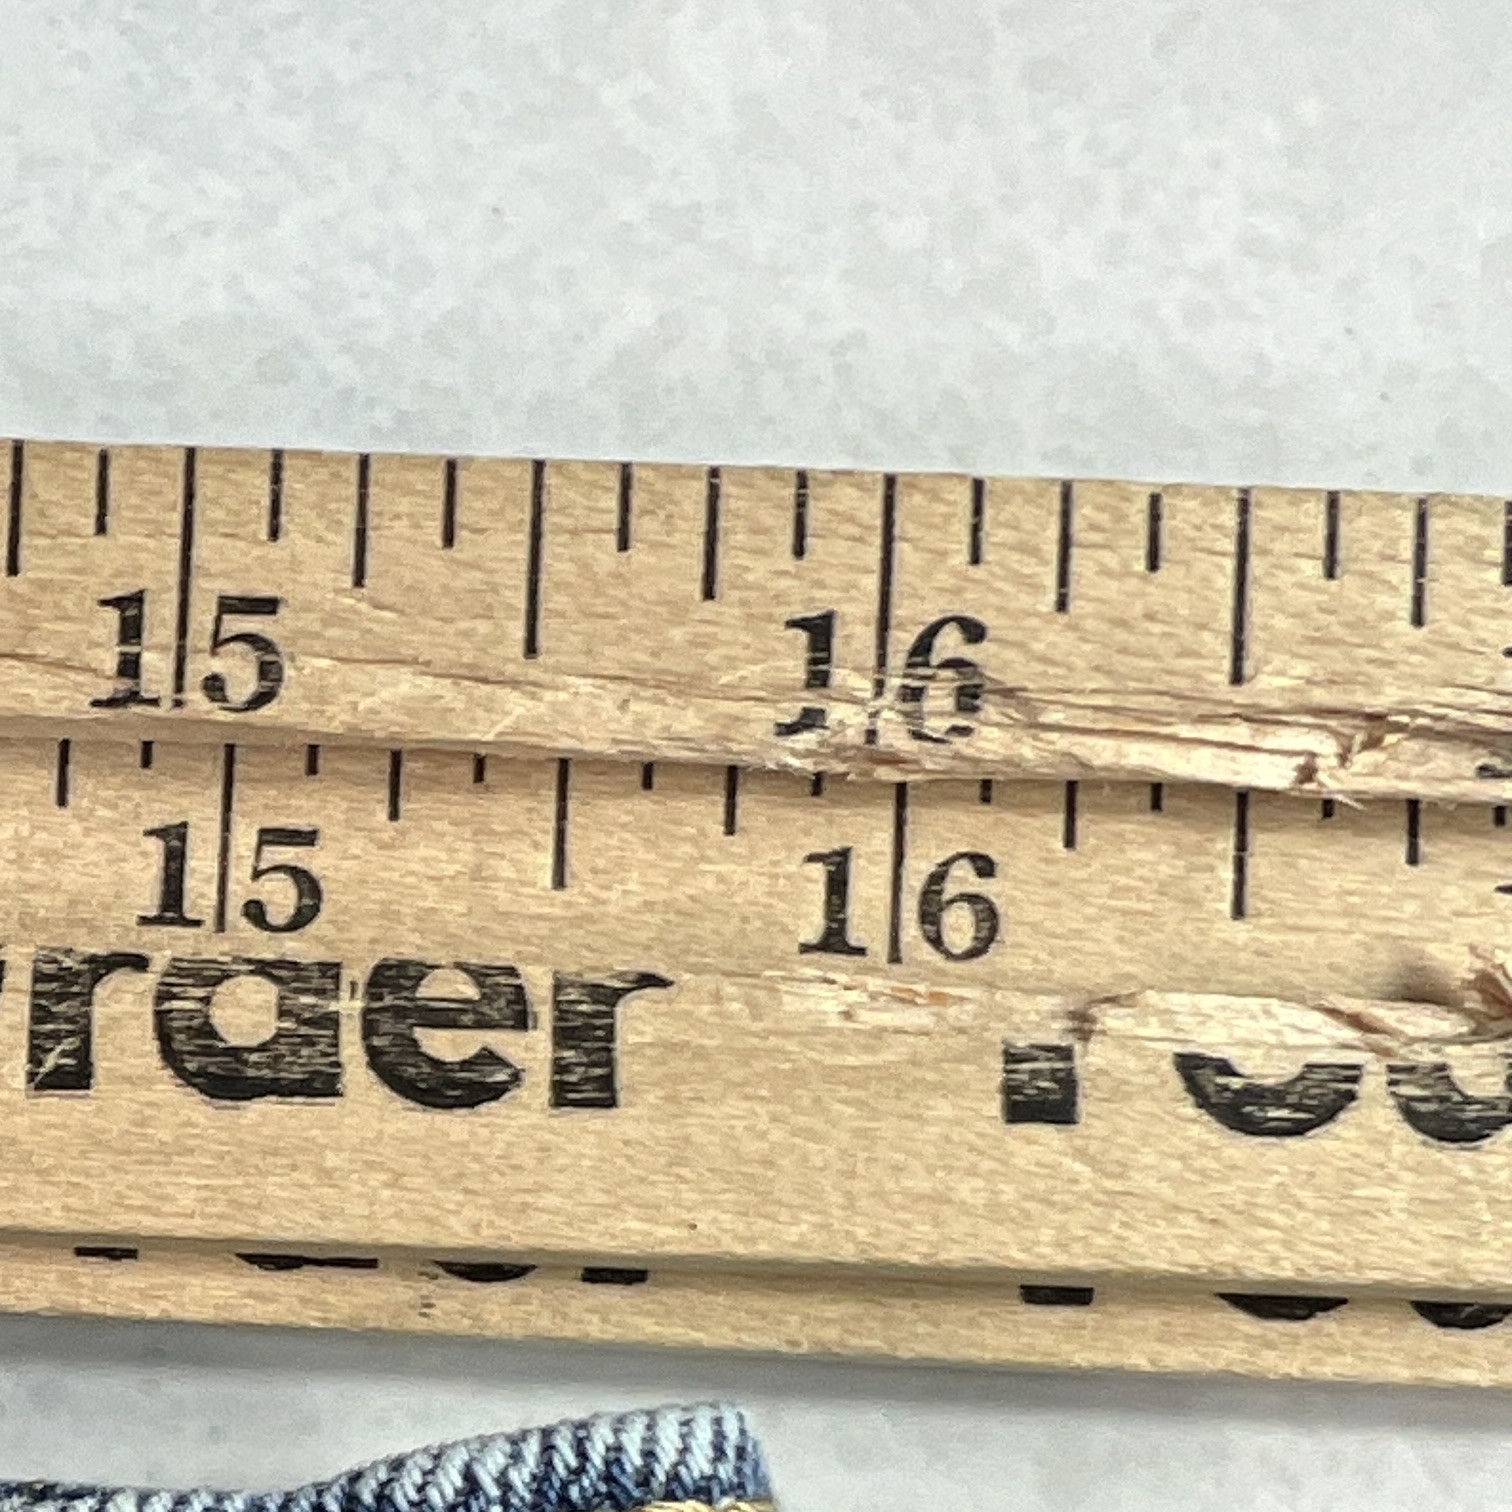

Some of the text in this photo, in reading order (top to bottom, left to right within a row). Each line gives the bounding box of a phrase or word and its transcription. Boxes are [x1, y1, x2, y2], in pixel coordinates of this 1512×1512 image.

[88, 588, 286, 713] 15
[774, 609, 989, 744] 16
[135, 820, 324, 934] 15
[797, 845, 1002, 963] 16
